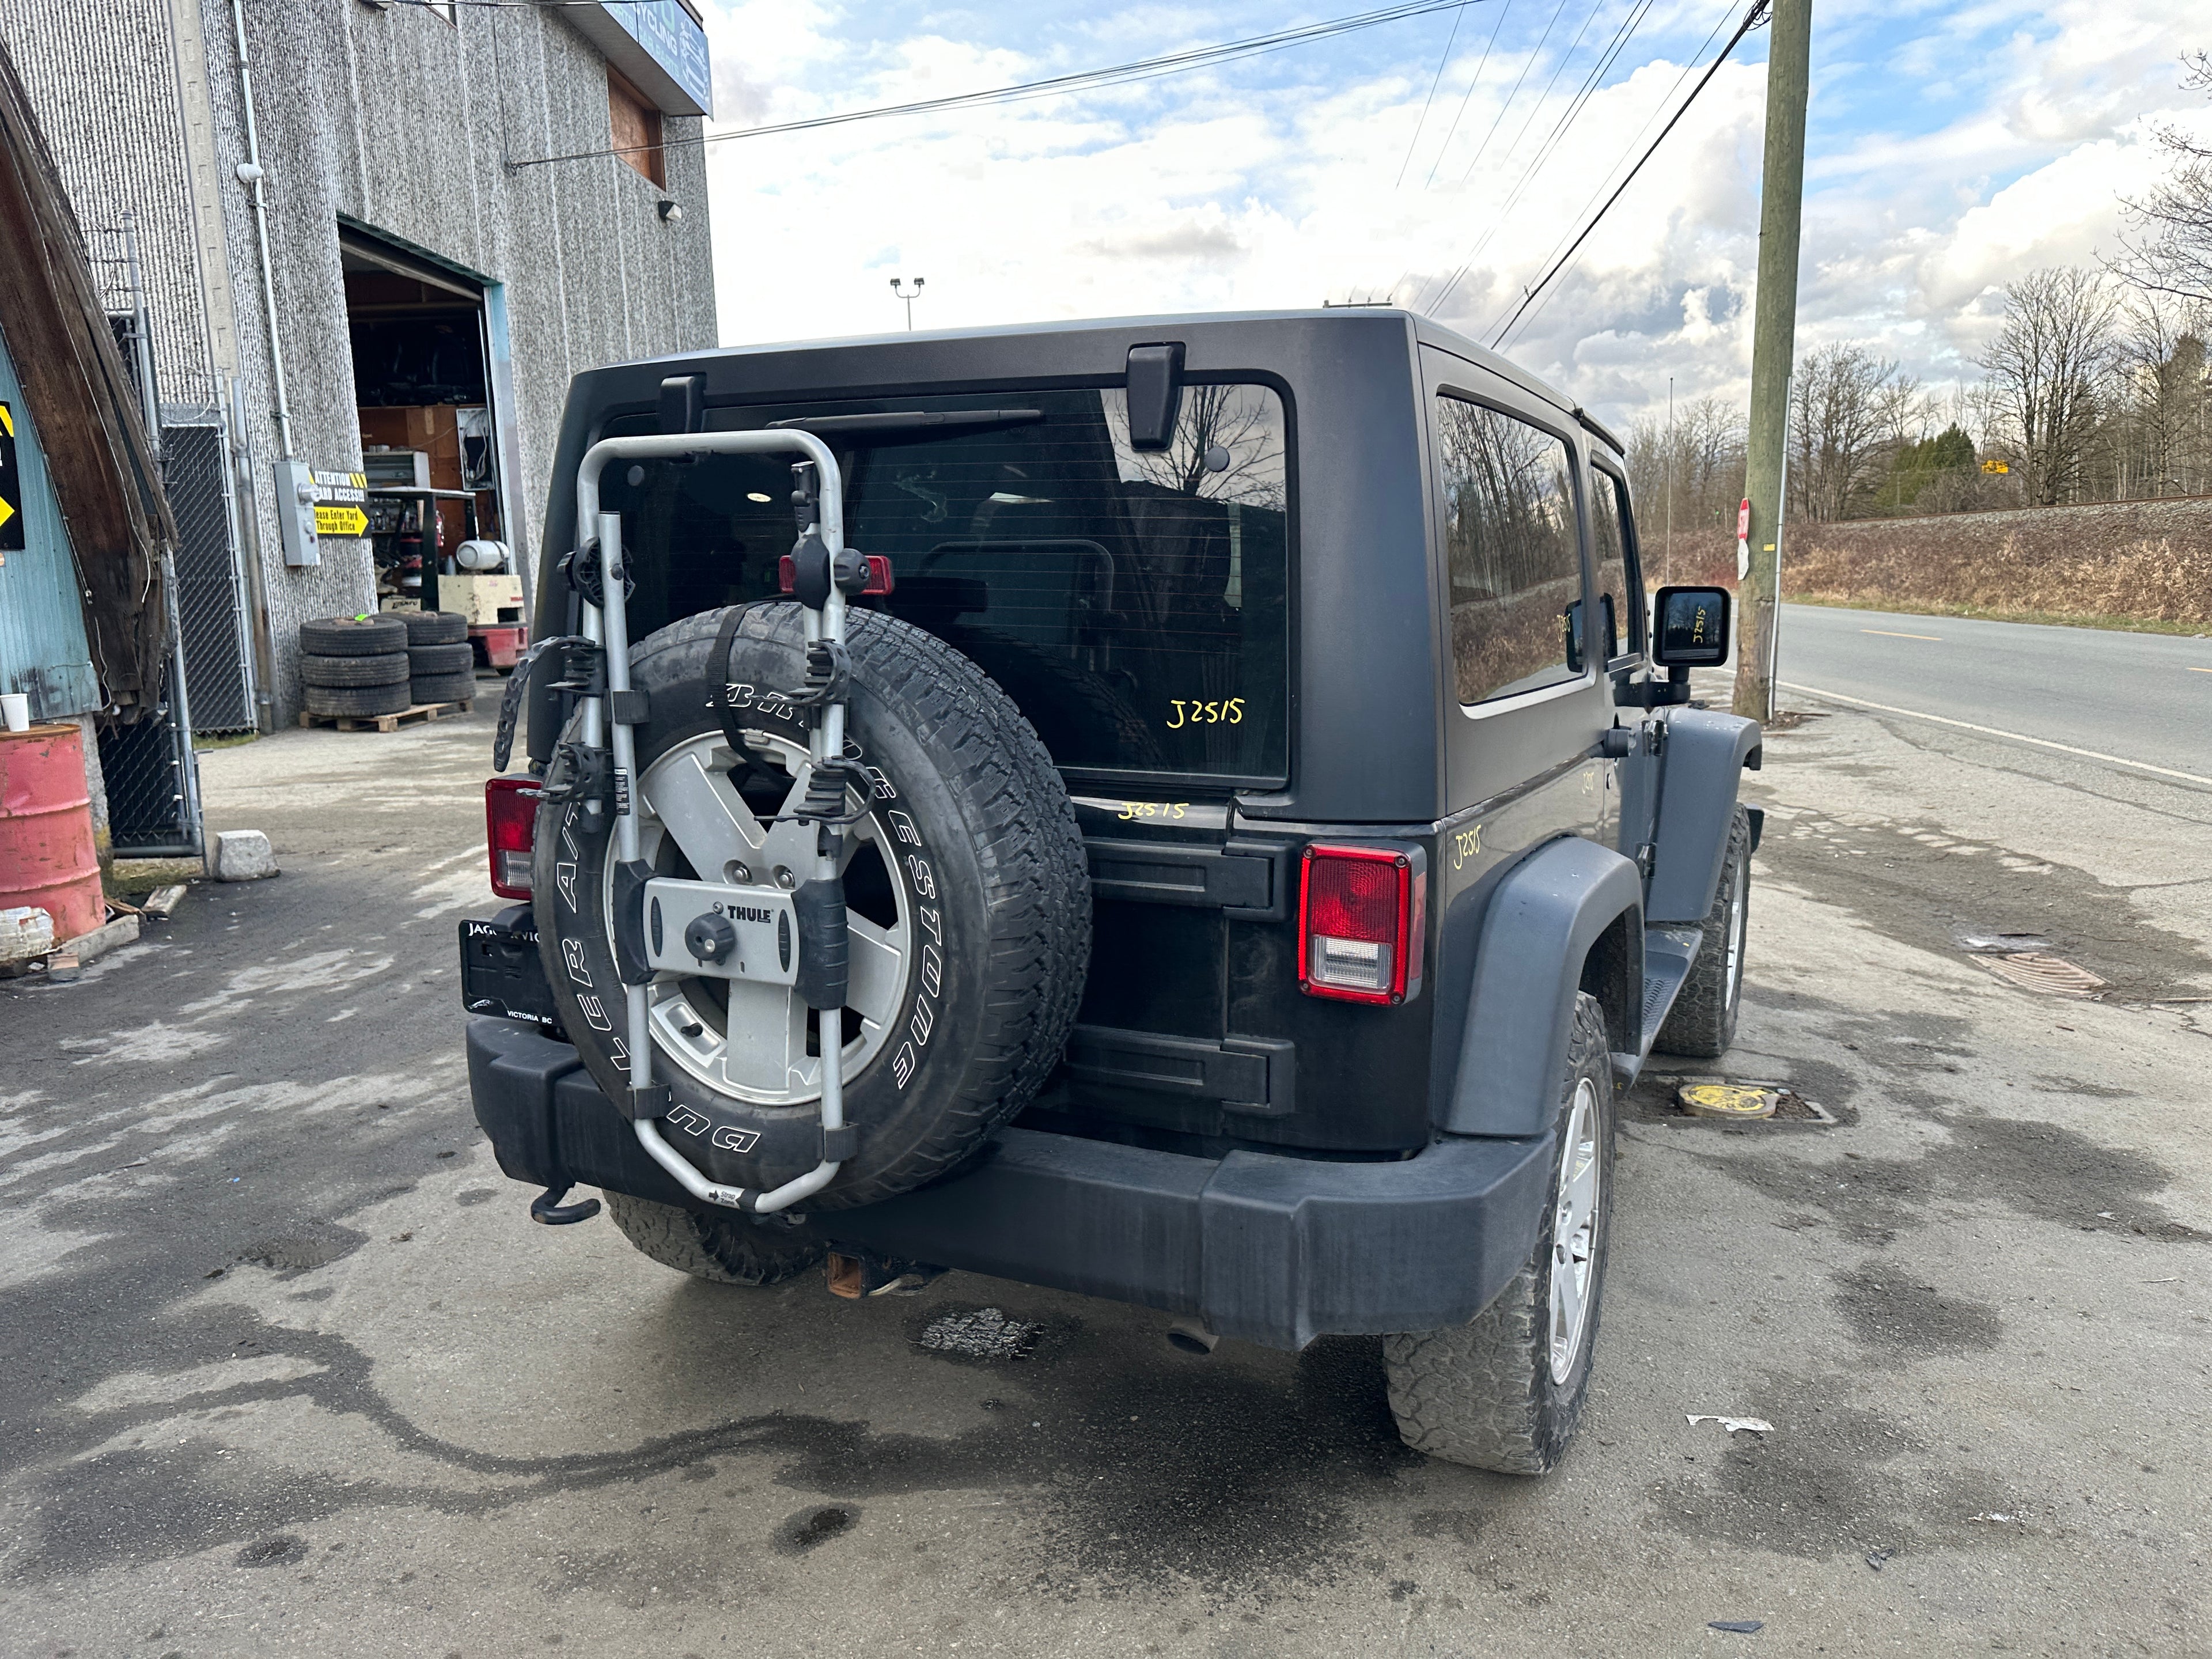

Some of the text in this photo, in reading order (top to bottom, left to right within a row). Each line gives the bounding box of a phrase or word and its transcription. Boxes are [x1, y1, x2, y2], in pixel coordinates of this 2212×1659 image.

[315, 470, 351, 486] ATTENTION
[319, 487, 332, 501] ARD
[316, 510, 358, 521] ease Enter Yard
[316, 520, 355, 533] Through Office
[1693, 605, 1706, 643] J2515
[1166, 698, 1245, 729] J2515
[1118, 802, 1190, 819] J2515
[1453, 824, 1482, 870] J2515
[727, 905, 771, 923] THULE
[507, 1010, 552, 1024] VICTORIA BC
[721, 1191, 736, 1200] Strap
